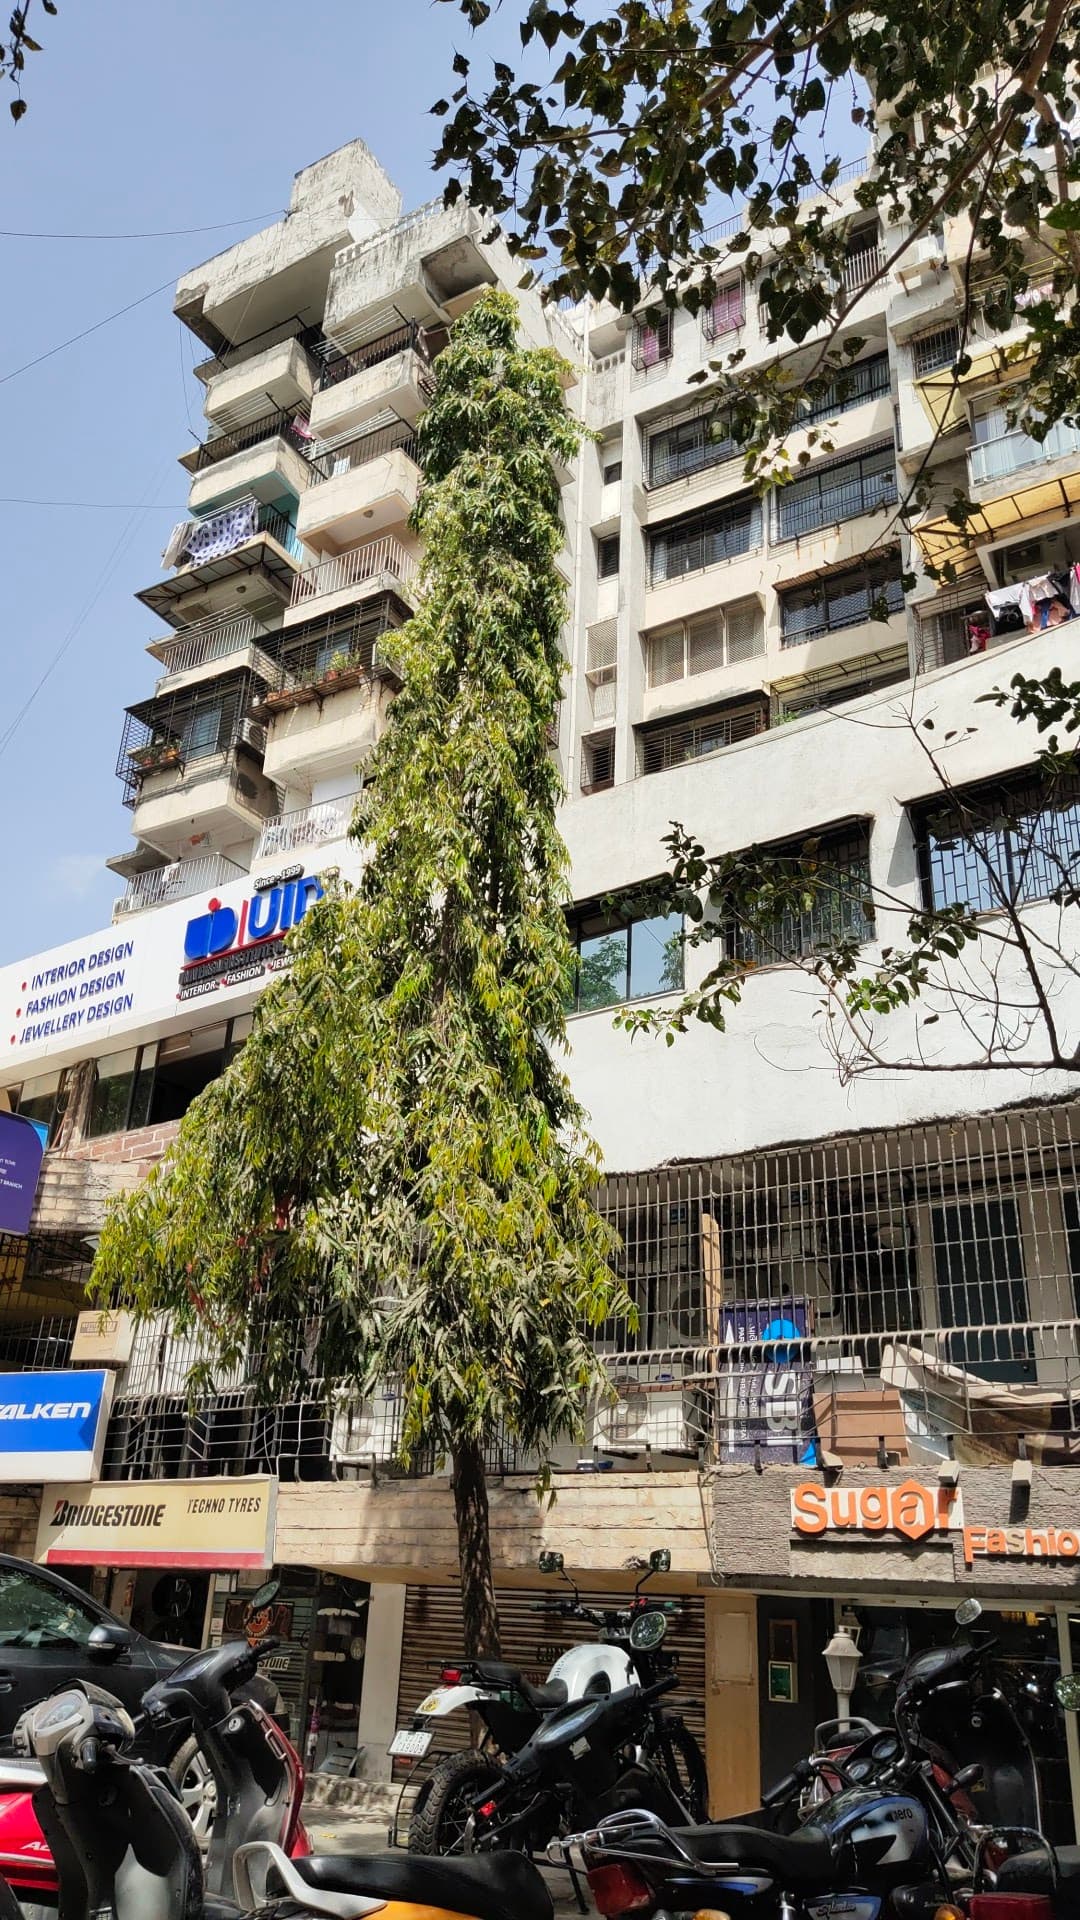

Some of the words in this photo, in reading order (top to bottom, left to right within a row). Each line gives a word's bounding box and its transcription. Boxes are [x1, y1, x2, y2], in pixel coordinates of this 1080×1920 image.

[254, 876, 275, 890] Since
[281, 864, 301, 880] 1999
[31, 958, 86, 991] INTERIOR
[88, 940, 134, 971] DESIGN
[180, 981, 216, 1000] INTERIOR
[226, 966, 262, 986] FASHION
[26, 986, 77, 1018] FASHION
[79, 969, 125, 999] DESIGN
[20, 1008, 85, 1045] JEWELLERY
[87, 993, 134, 1024] DESIGN
[764, 1369, 803, 1446] SBI
[50, 1500, 166, 1527] BRIDGESTONE
[187, 1498, 224, 1514] TECHNO
[229, 1497, 262, 1513] TYRES
[793, 1479, 957, 1540] Sugar
[963, 1527, 1080, 1563] Fashio
